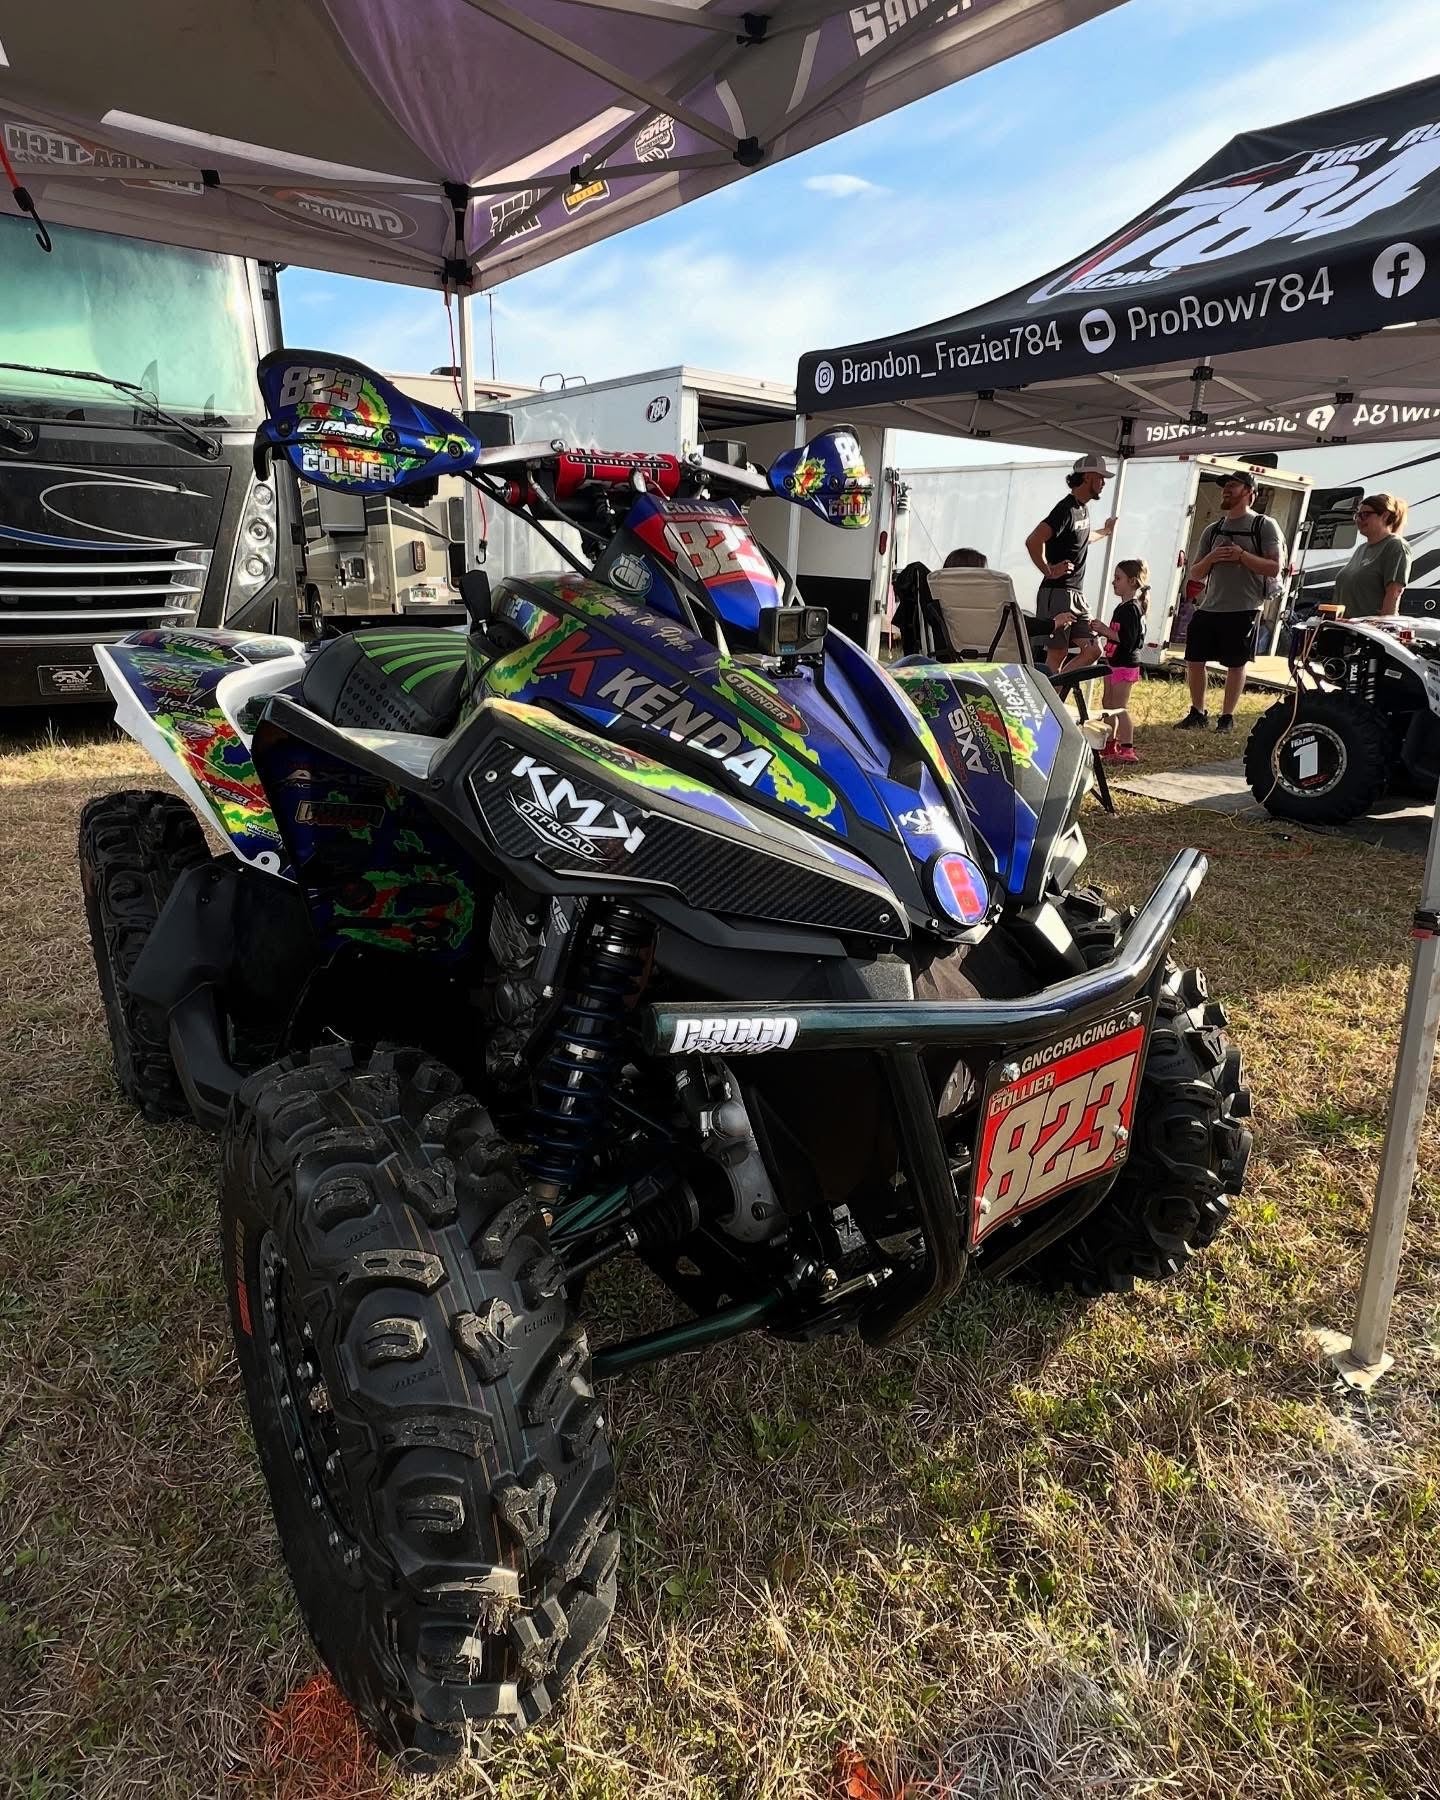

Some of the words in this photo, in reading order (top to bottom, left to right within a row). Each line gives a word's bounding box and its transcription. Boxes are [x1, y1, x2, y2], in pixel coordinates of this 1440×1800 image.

[1295, 137, 1388, 174] PRO
[1127, 266, 1334, 341] ProRow784
[841, 320, 1063, 385] Brandon_Frazier784
[280, 366, 365, 411] 823
[322, 420, 379, 438] FASST
[302, 454, 396, 483] COLLIER
[569, 455, 670, 469] handlebars
[664, 501, 733, 517] COLLIER
[160, 633, 218, 651] KENDA
[726, 673, 789, 720] GTHUNDER
[596, 667, 774, 787] KENDA
[948, 708, 989, 775] AXIS
[1293, 742, 1318, 779] 1
[519, 802, 596, 855] OFFROAD
[989, 1071, 1057, 1118] COLLIER
[977, 1053, 1136, 1238] 823
